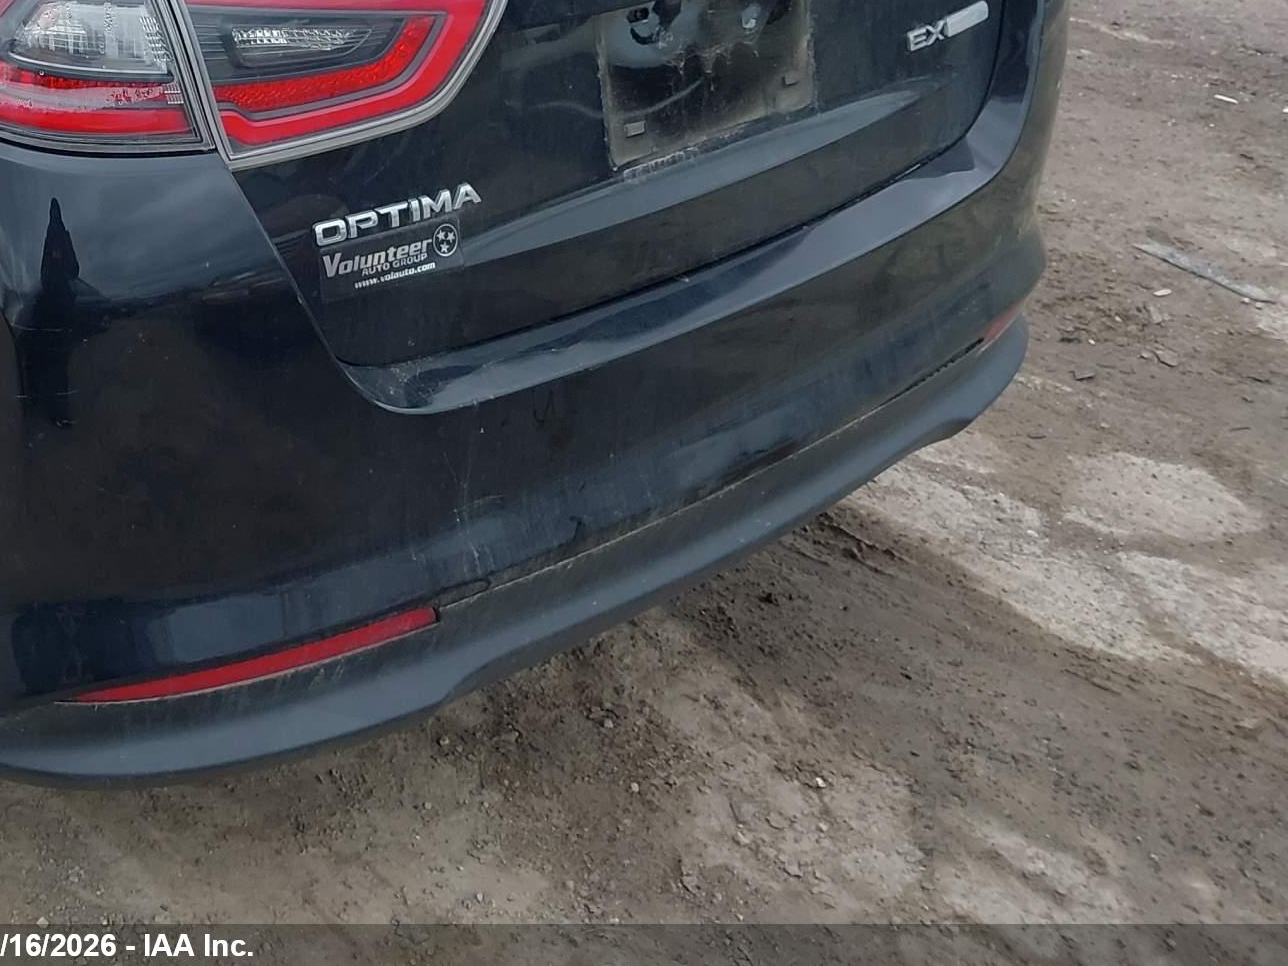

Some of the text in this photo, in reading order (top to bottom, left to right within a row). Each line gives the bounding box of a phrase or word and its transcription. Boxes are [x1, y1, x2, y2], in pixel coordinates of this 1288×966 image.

[907, 20, 945, 52] EX
[313, 182, 481, 247] OPTIMA
[322, 238, 433, 278] Volunteer
[362, 253, 428, 277] AUTO GROUP
